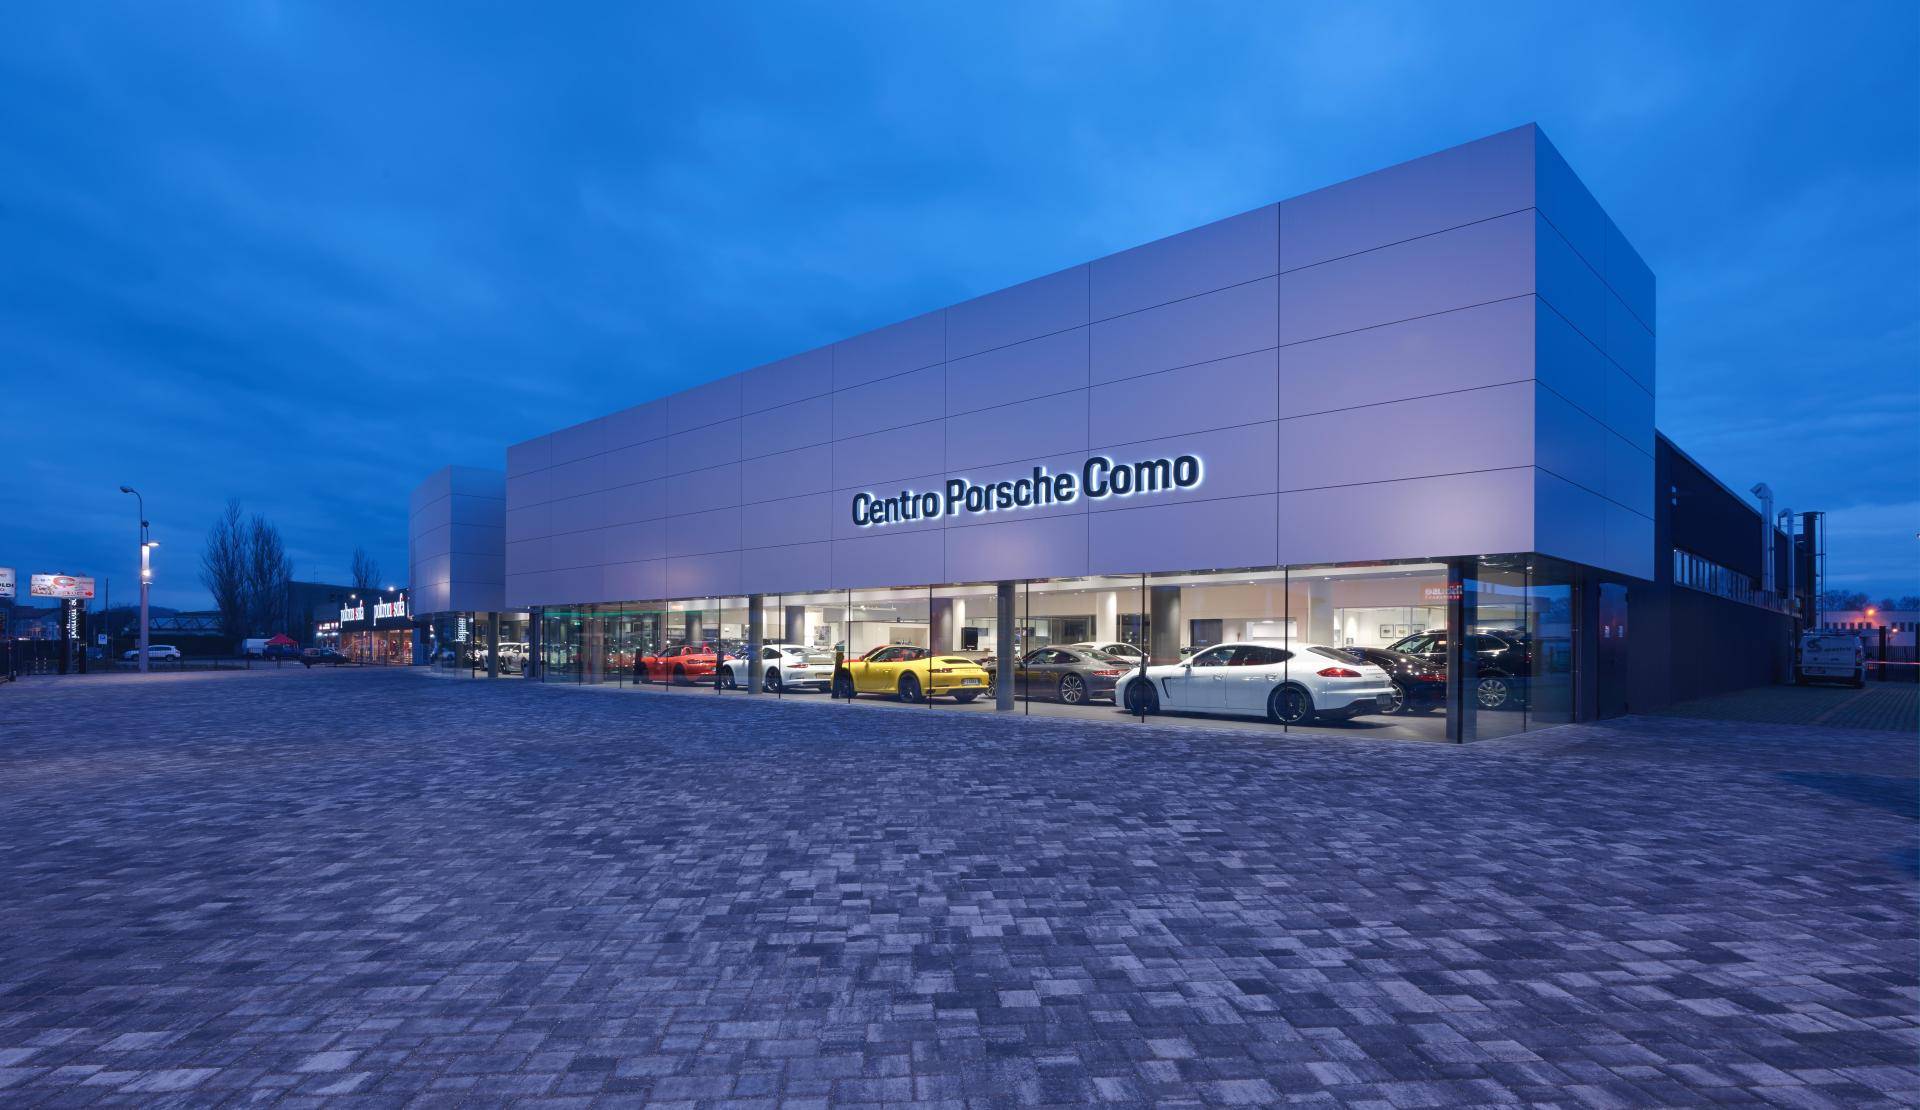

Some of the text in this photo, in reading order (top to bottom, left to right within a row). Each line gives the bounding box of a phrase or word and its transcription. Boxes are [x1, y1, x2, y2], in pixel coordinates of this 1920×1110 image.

[852, 454, 1202, 527] Centro Porsche Como
